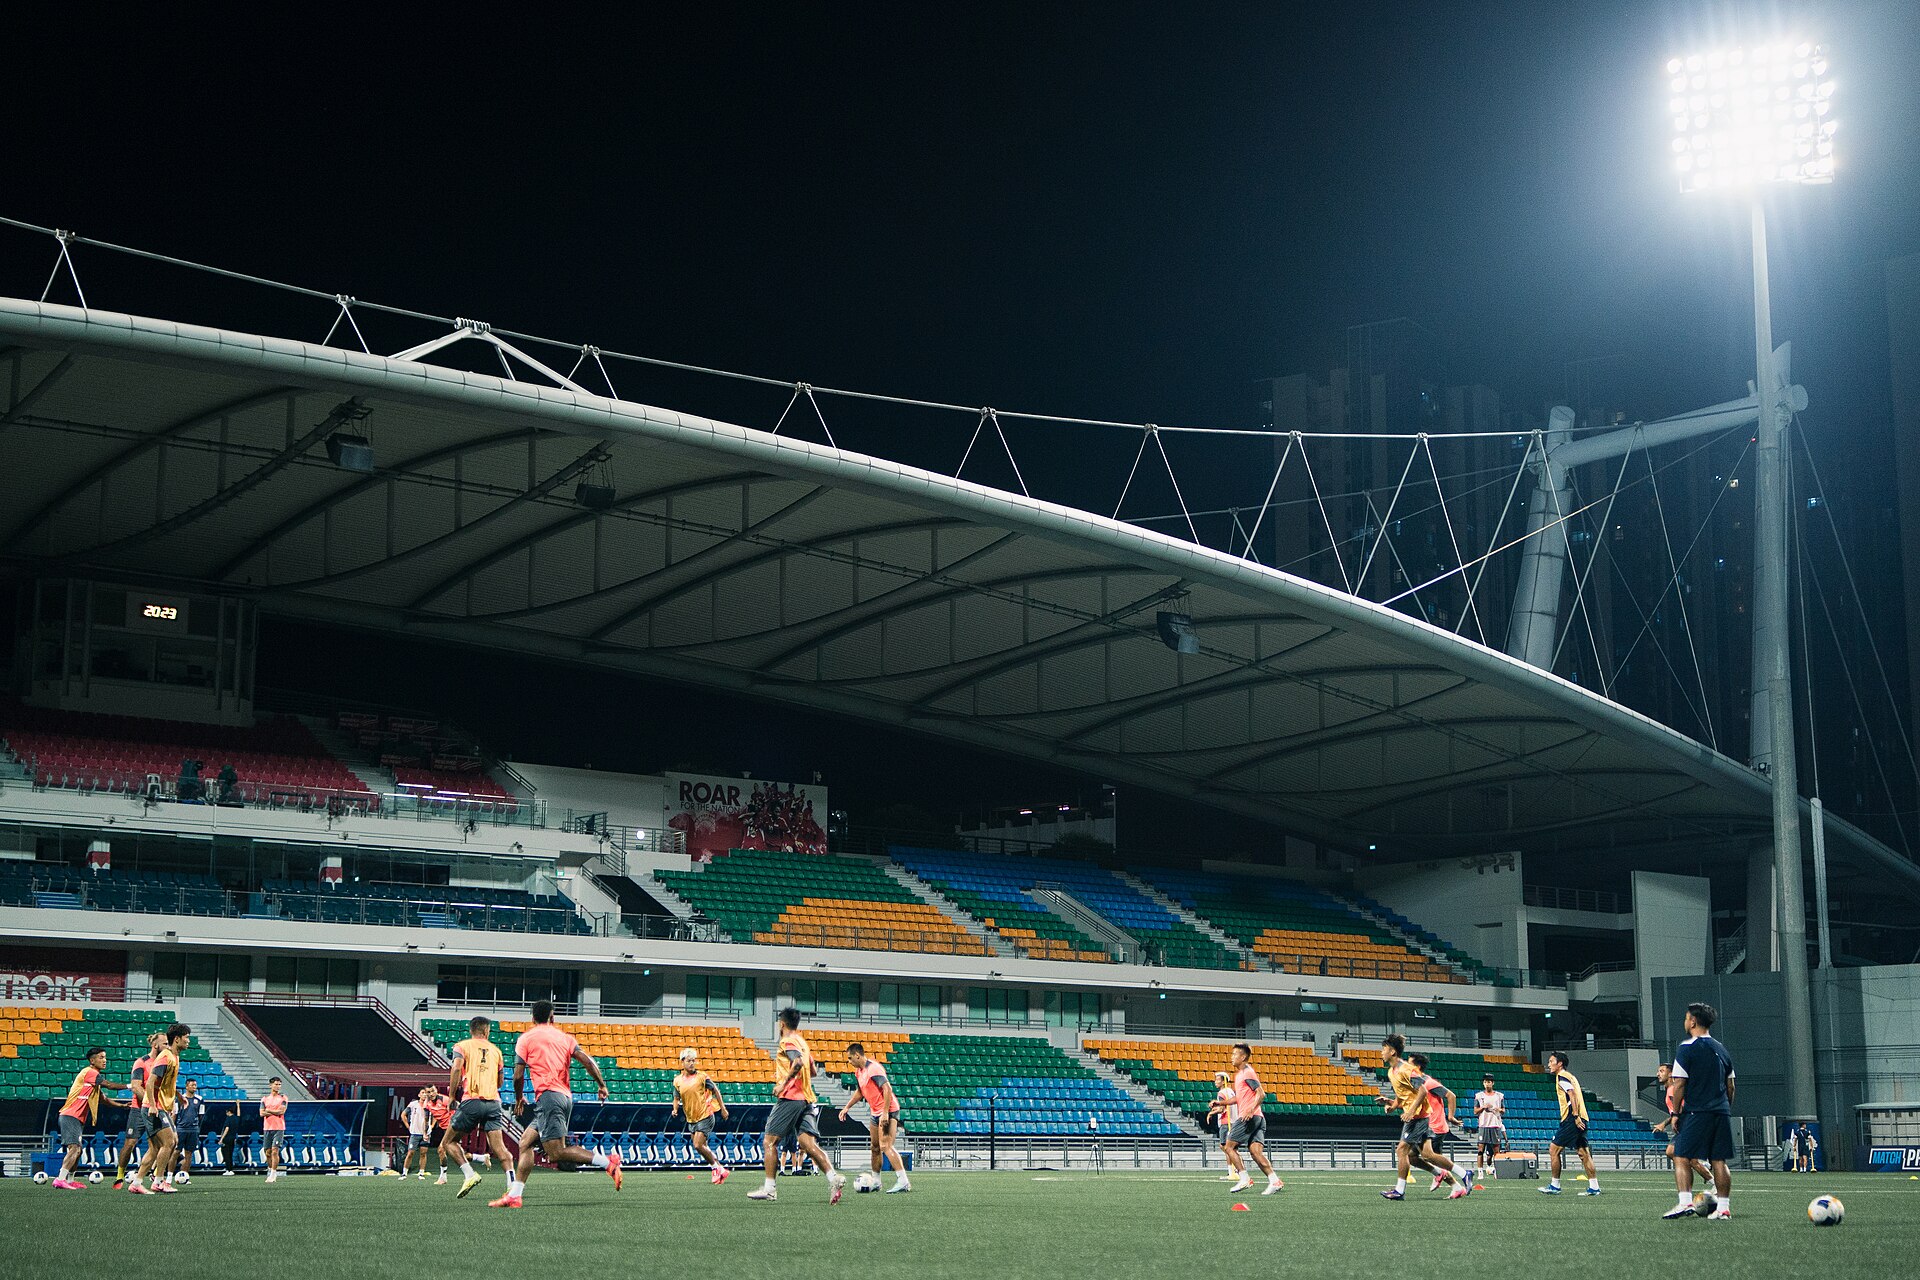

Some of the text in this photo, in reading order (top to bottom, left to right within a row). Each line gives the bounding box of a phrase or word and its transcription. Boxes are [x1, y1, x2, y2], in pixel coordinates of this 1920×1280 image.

[680, 781, 741, 807] ROAR
[680, 801, 740, 815] FOR THE NATION
[1872, 1151, 1903, 1165] MATCH
